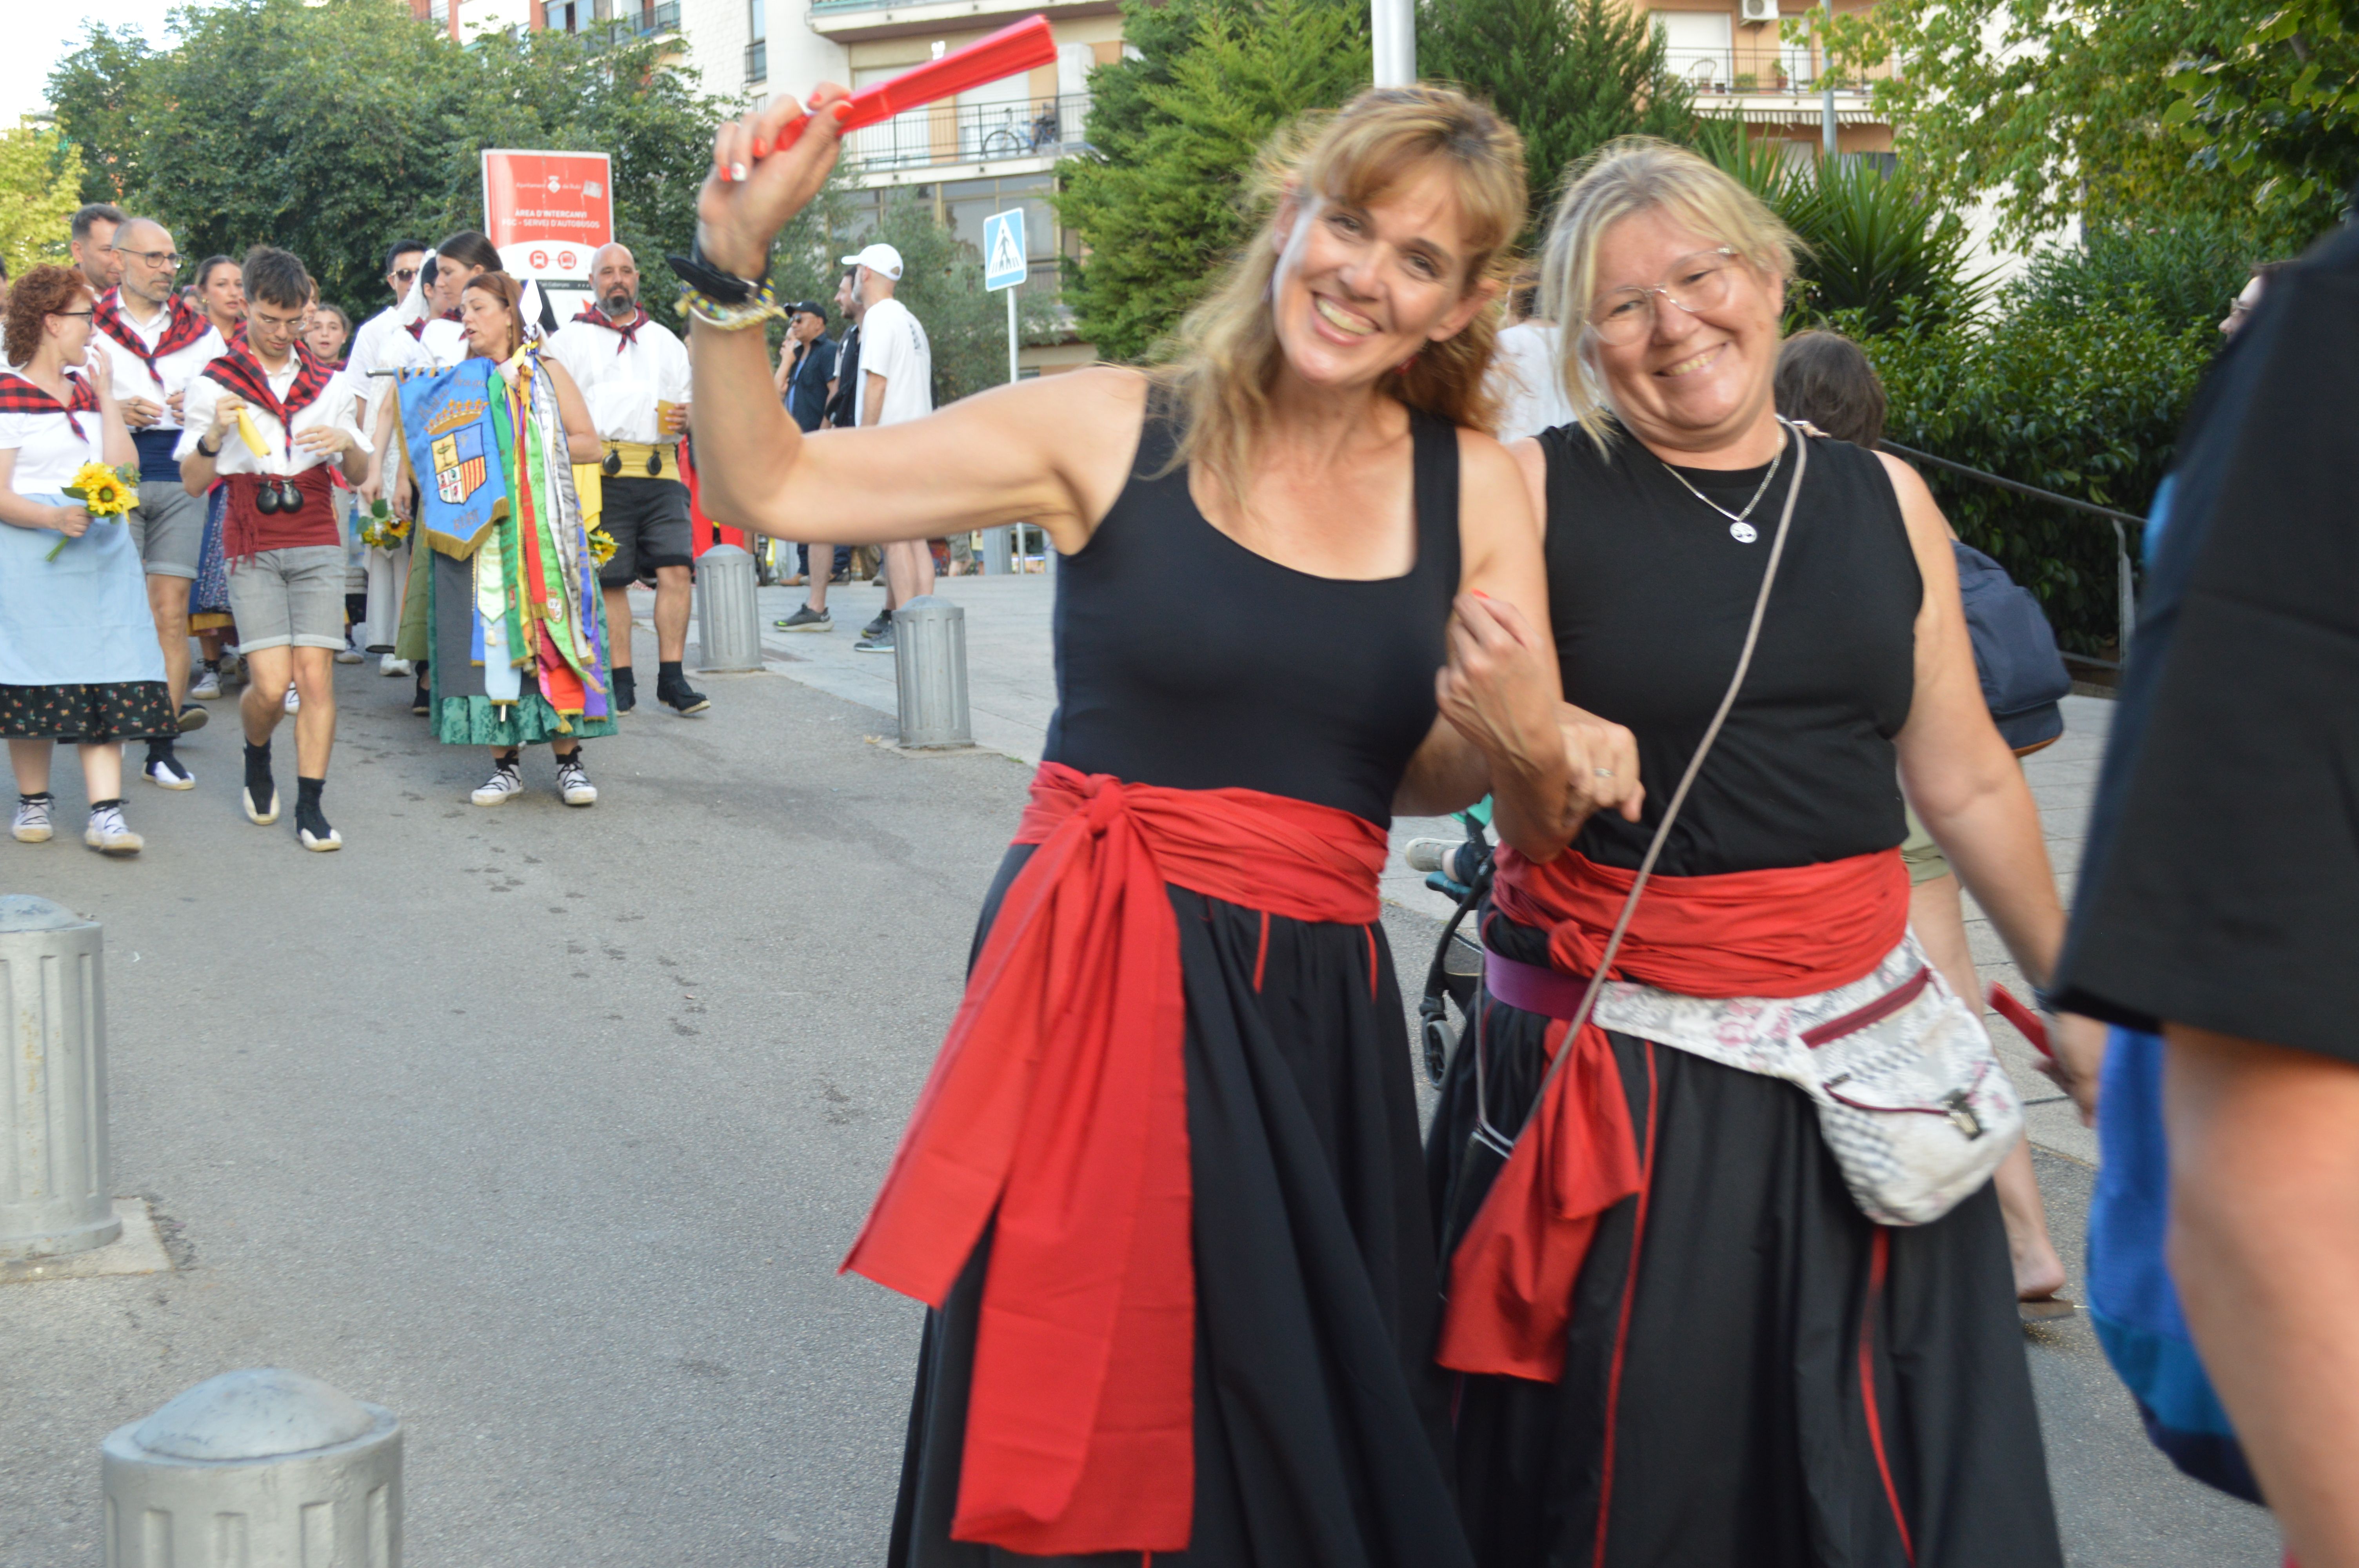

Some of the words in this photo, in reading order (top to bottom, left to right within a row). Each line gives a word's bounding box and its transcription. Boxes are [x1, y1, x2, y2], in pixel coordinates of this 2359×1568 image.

[515, 208, 534, 216] ÀREA
[536, 210, 587, 218] D'INTERCANVI
[523, 219, 549, 227] SERVEI
[551, 220, 600, 229] D'AUTOBUSOS
